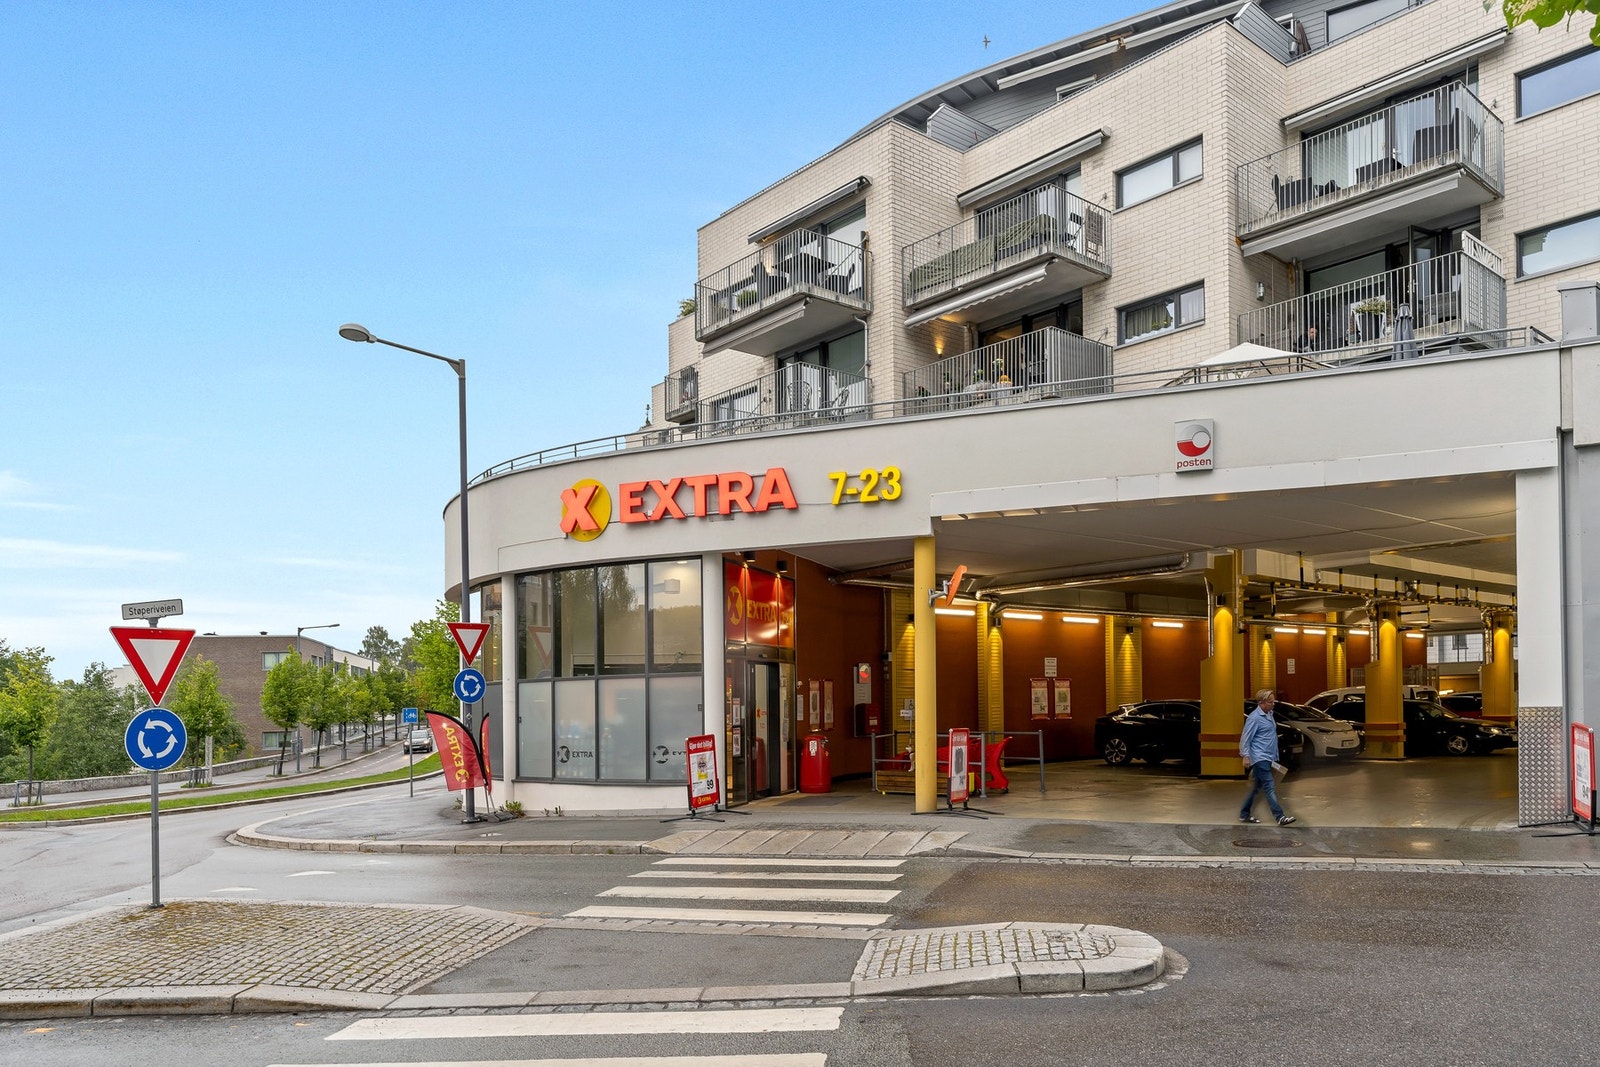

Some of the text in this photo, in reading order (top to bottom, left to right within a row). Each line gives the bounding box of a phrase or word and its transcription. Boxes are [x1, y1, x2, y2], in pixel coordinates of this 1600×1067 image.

[1177, 458, 1211, 470] posten
[828, 465, 903, 506] 7-23
[619, 467, 799, 524] EXTRA
[128, 605, 176, 616] Støperiveien
[746, 599, 778, 622] EXTRA
[572, 751, 593, 759] EXTRA
